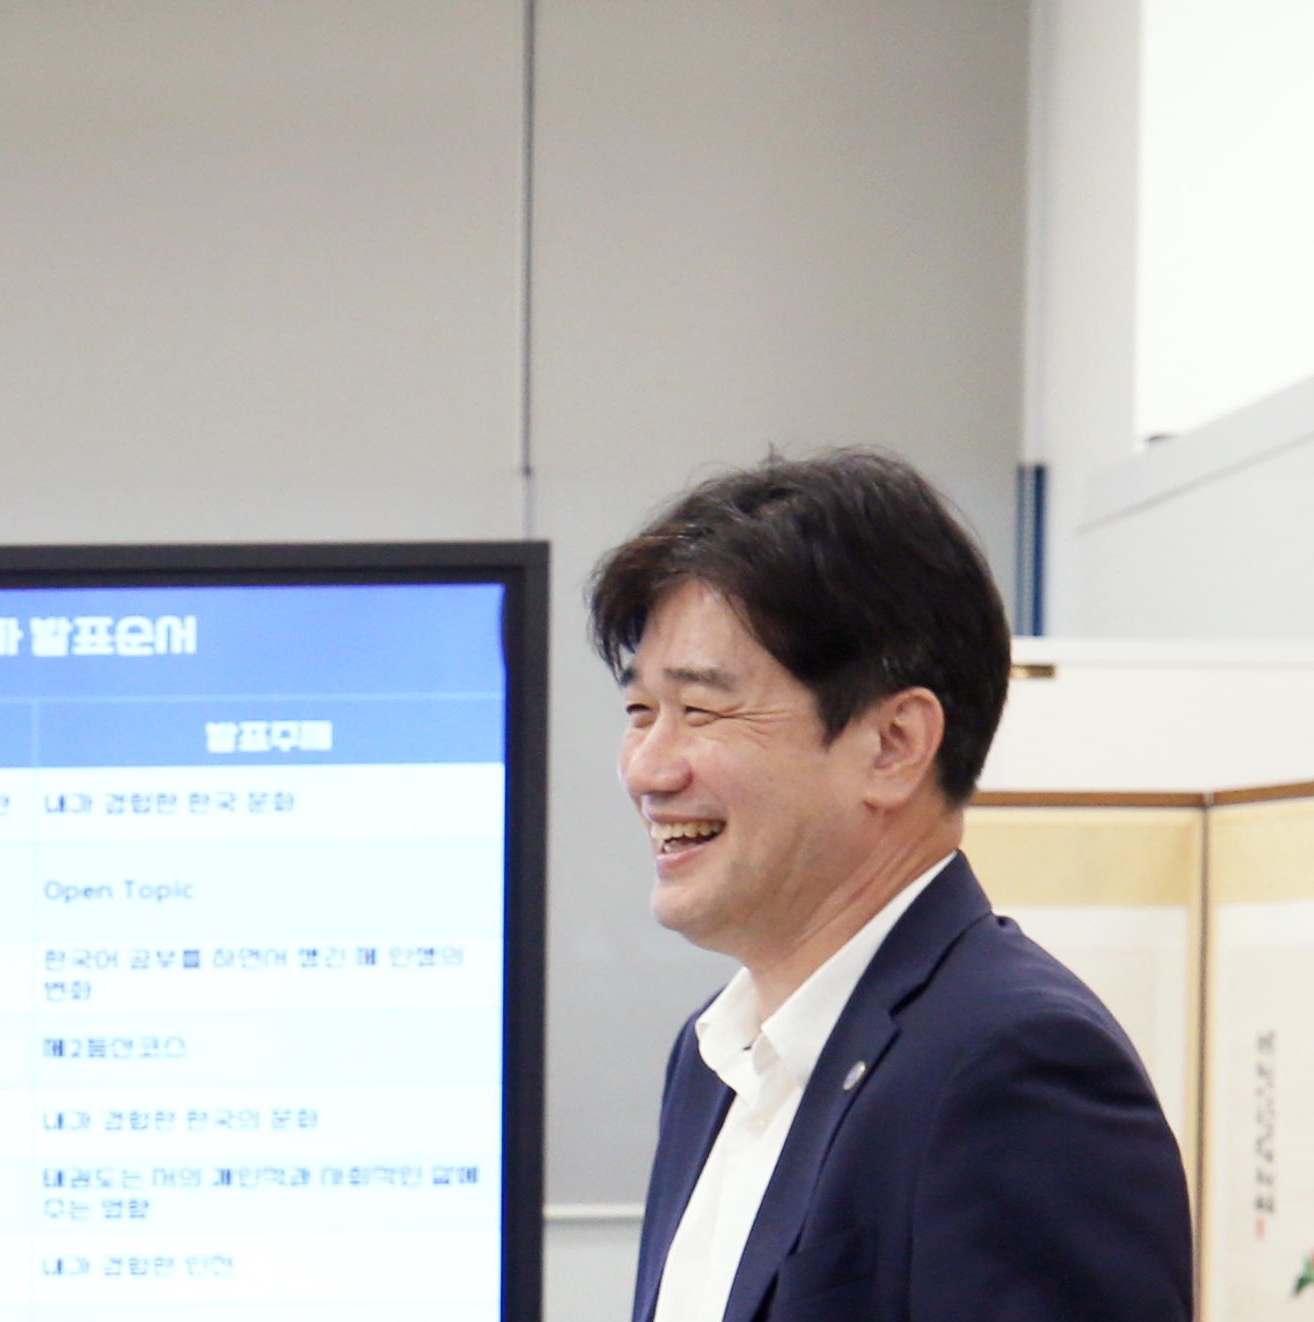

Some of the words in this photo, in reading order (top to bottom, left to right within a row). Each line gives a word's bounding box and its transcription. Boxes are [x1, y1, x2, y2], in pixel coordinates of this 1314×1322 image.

[29, 615, 197, 657] 발표순서
[188, 792, 236, 814] 한국
[44, 881, 113, 904] Open
[123, 879, 193, 904] Topic
[45, 949, 118, 971] 한국어
